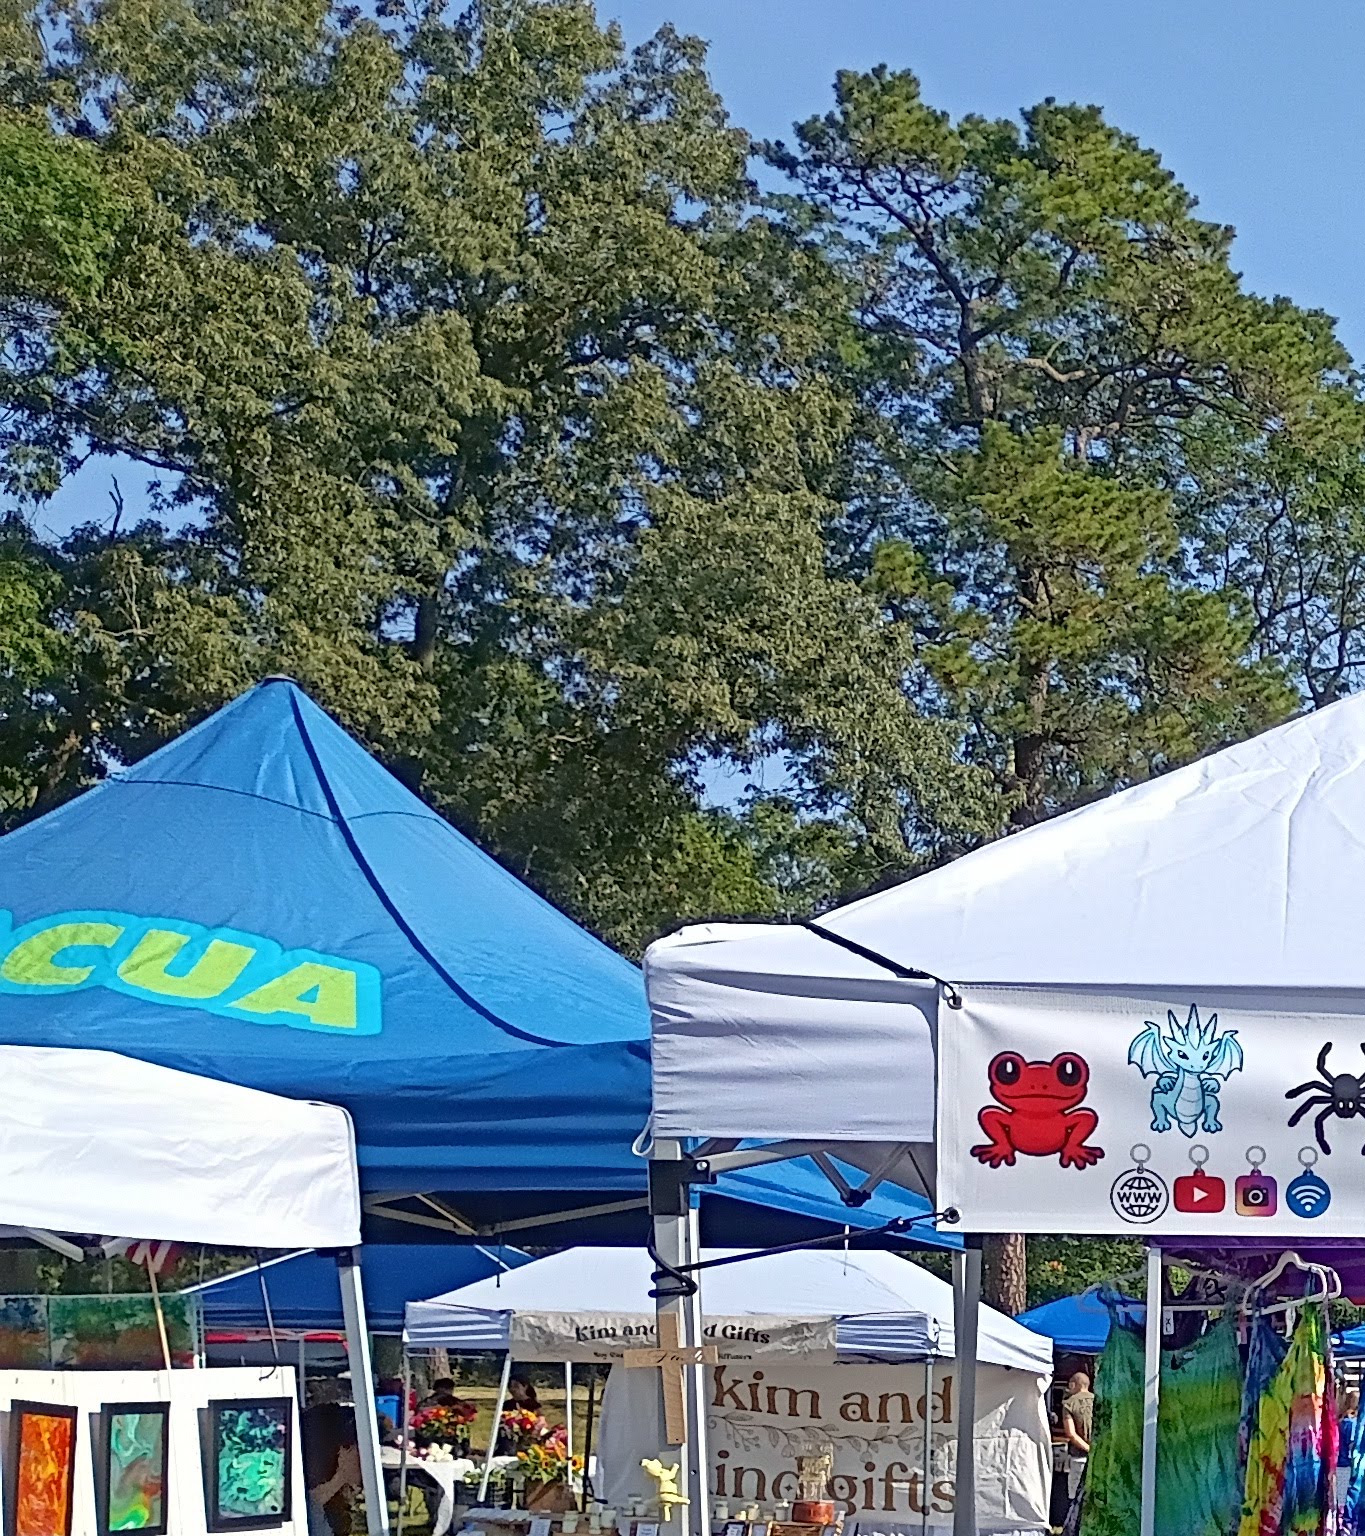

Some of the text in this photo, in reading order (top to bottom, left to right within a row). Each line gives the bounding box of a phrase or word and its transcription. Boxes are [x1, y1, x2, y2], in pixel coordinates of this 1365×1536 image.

[576, 1325, 617, 1343] Kim
[721, 1325, 771, 1345] Gifts
[712, 1365, 953, 1423] kim and
[827, 1461, 956, 1517] gifts
